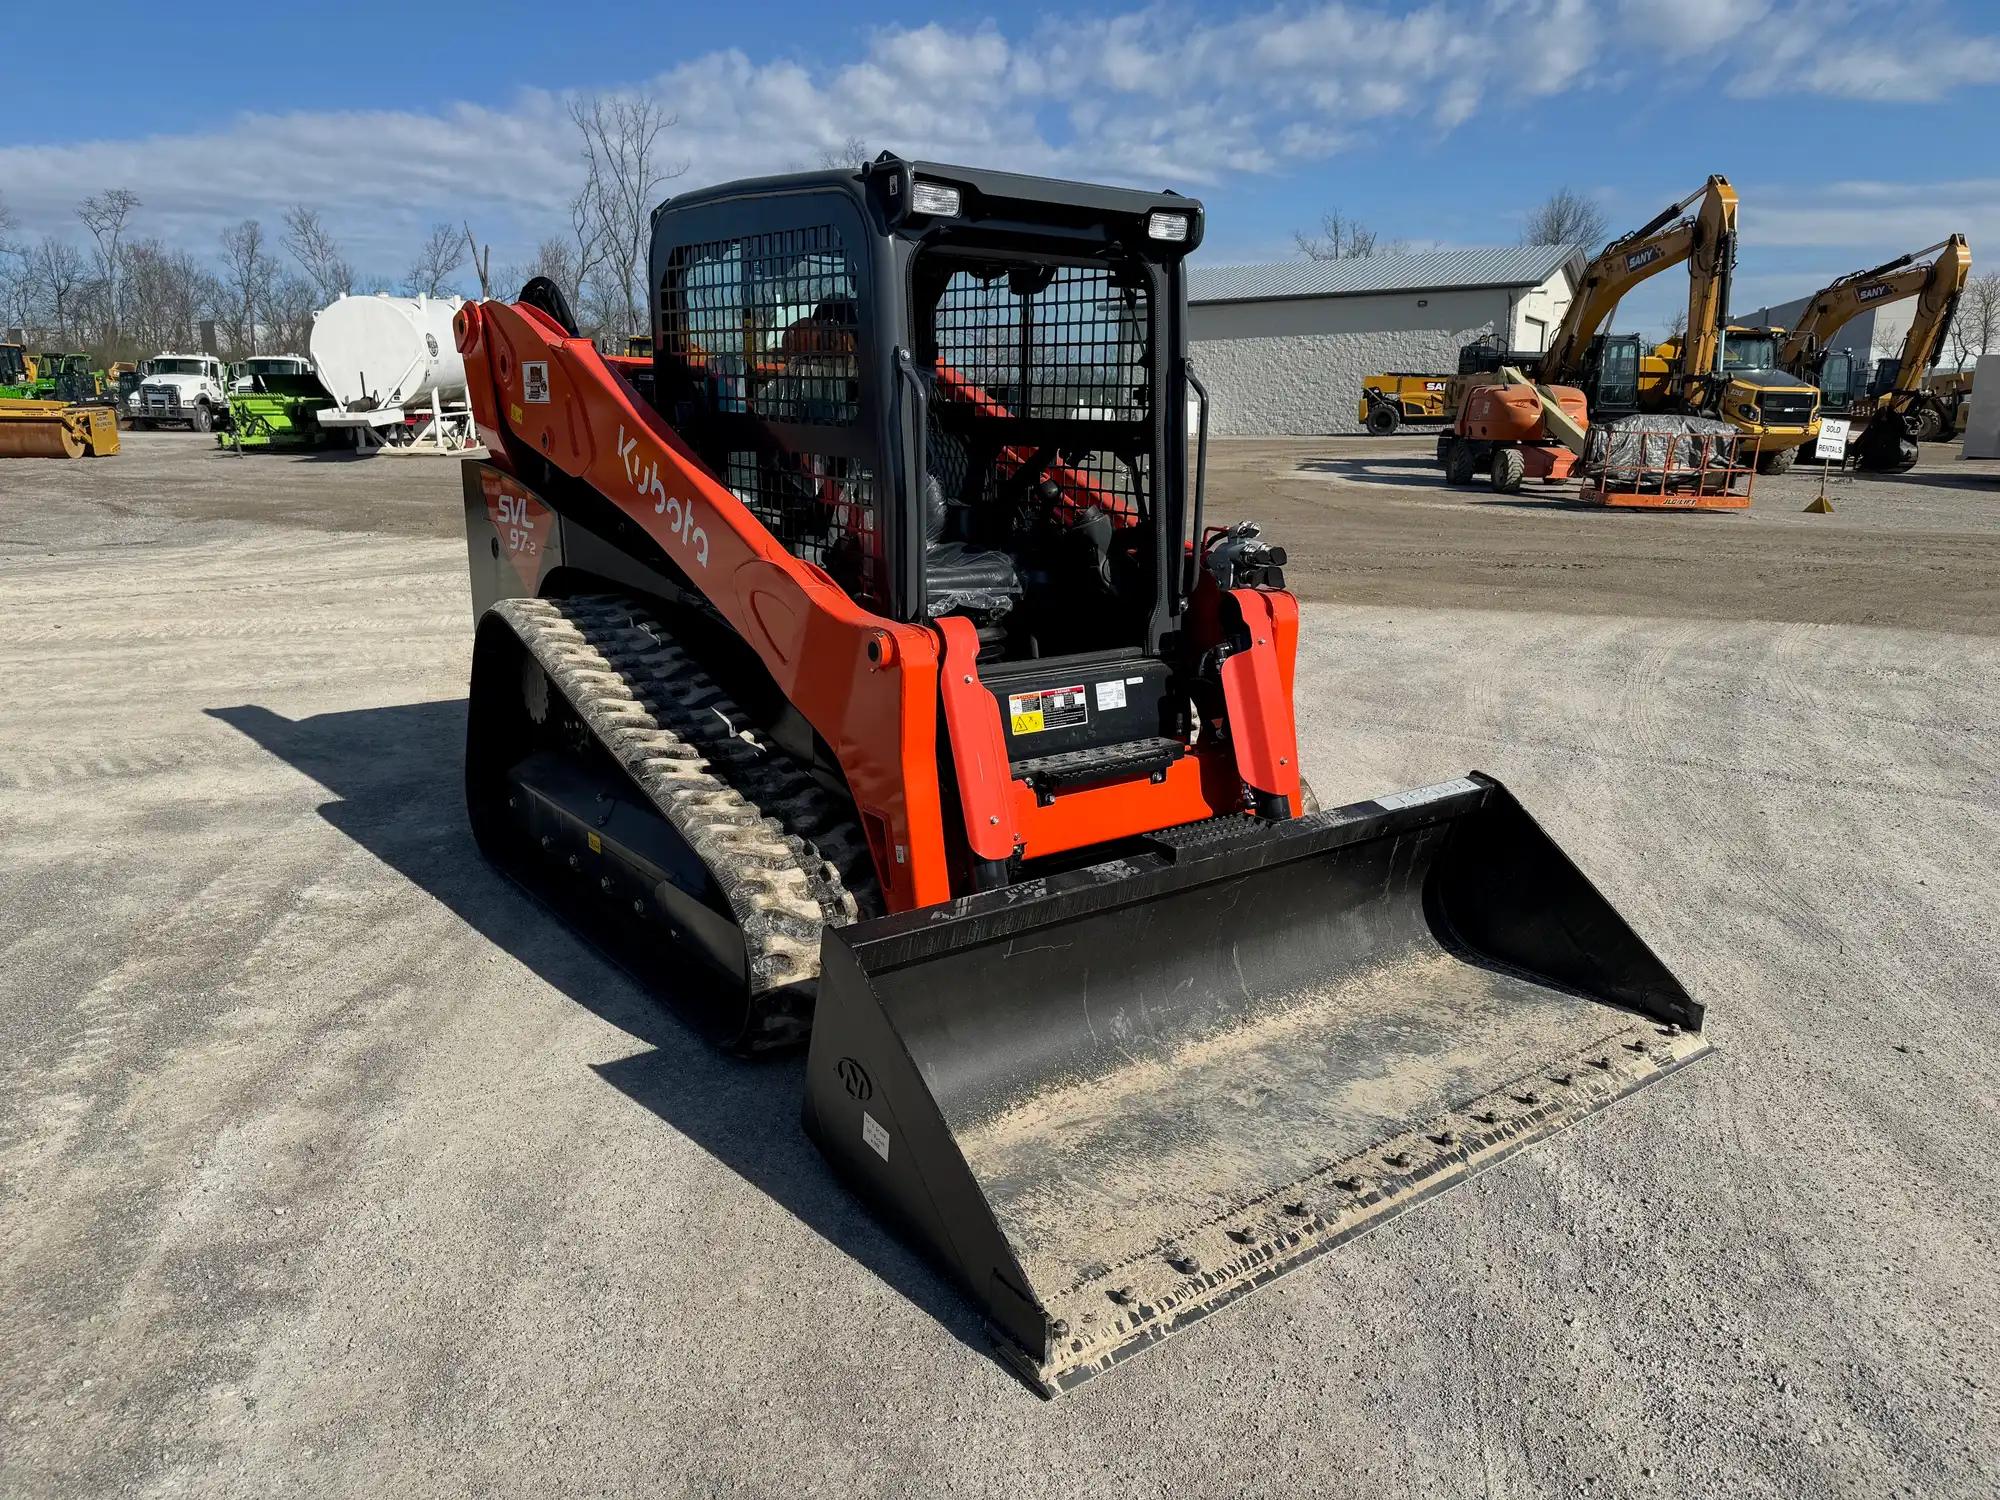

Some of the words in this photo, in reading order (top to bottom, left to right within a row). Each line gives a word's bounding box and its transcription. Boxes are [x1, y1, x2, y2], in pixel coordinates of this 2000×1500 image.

[1628, 248, 1654, 269] SANY
[1860, 285, 1886, 300] SANY
[1825, 425, 1842, 434] SOLD
[1817, 444, 1843, 454] RENTALS
[616, 423, 710, 569] Kubota
[496, 494, 535, 529] SVL
